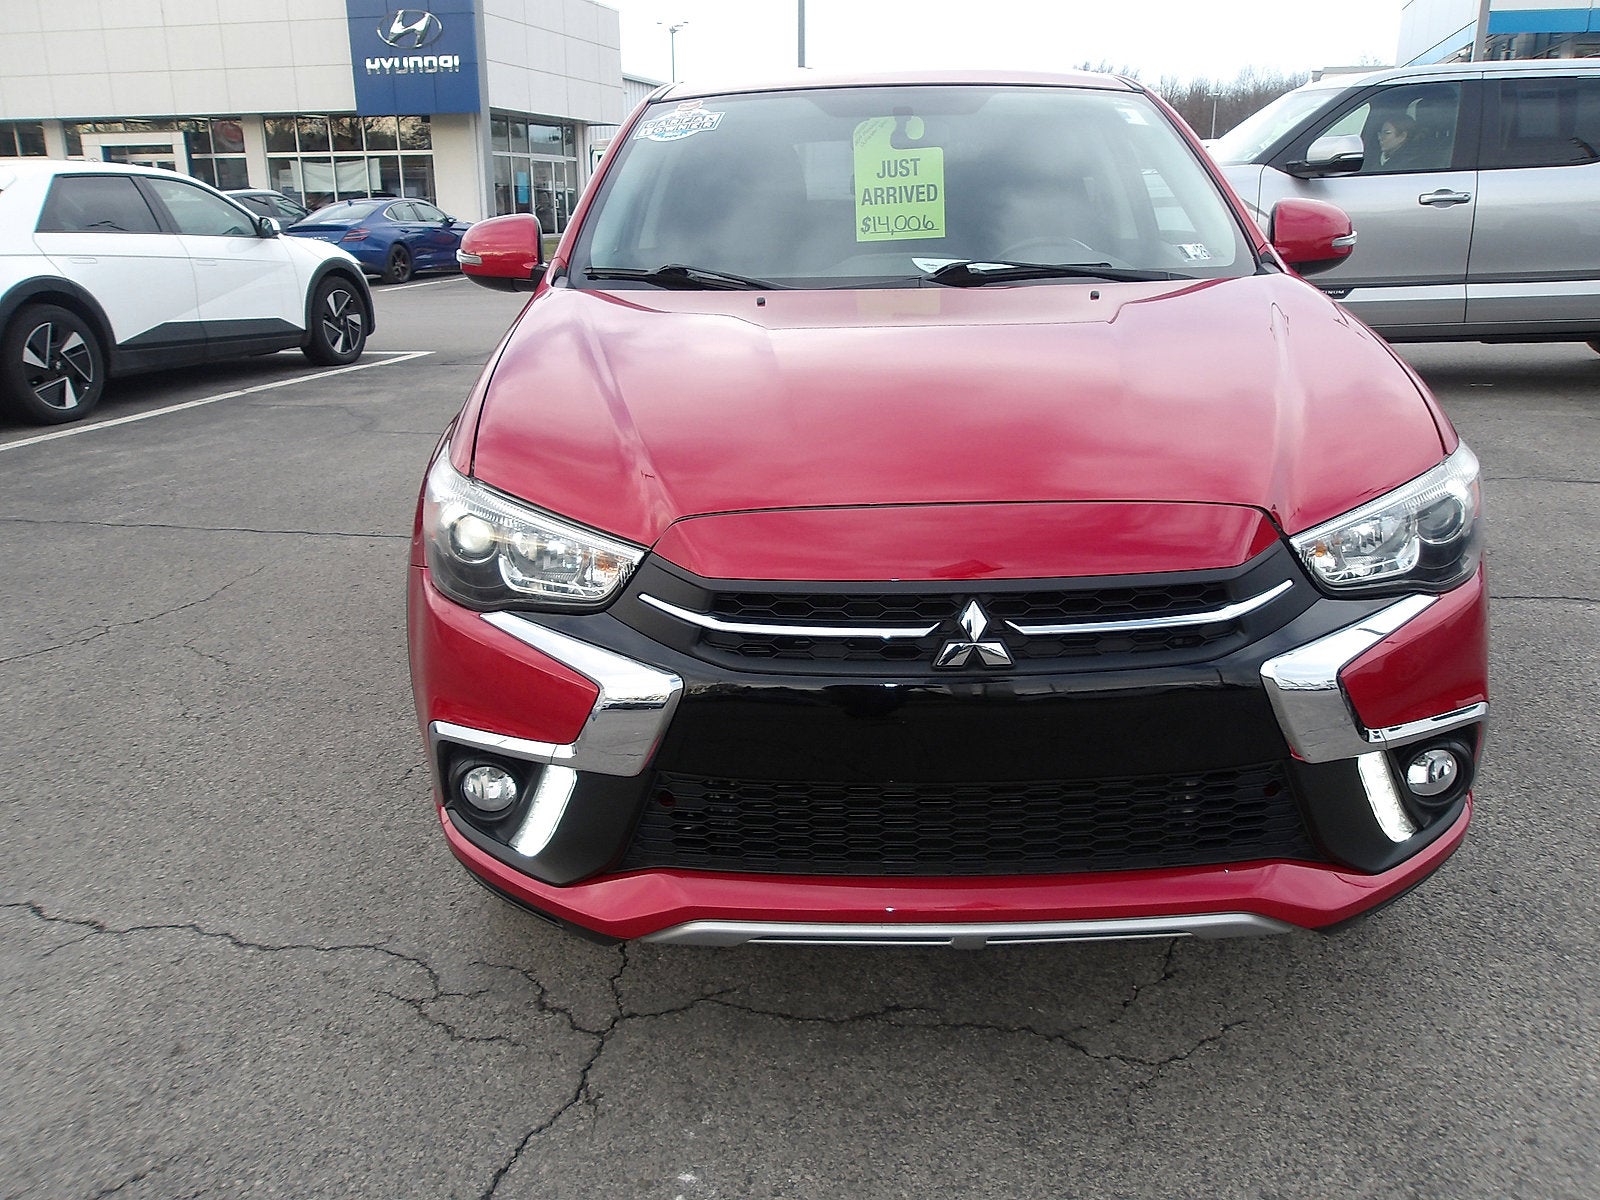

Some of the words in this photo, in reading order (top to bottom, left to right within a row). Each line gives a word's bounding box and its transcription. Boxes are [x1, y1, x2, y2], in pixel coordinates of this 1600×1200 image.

[365, 55, 460, 75] HYUNDAI
[876, 158, 921, 178] JUST
[861, 183, 938, 206] ARRIVED
[860, 214, 939, 235] $14,006
